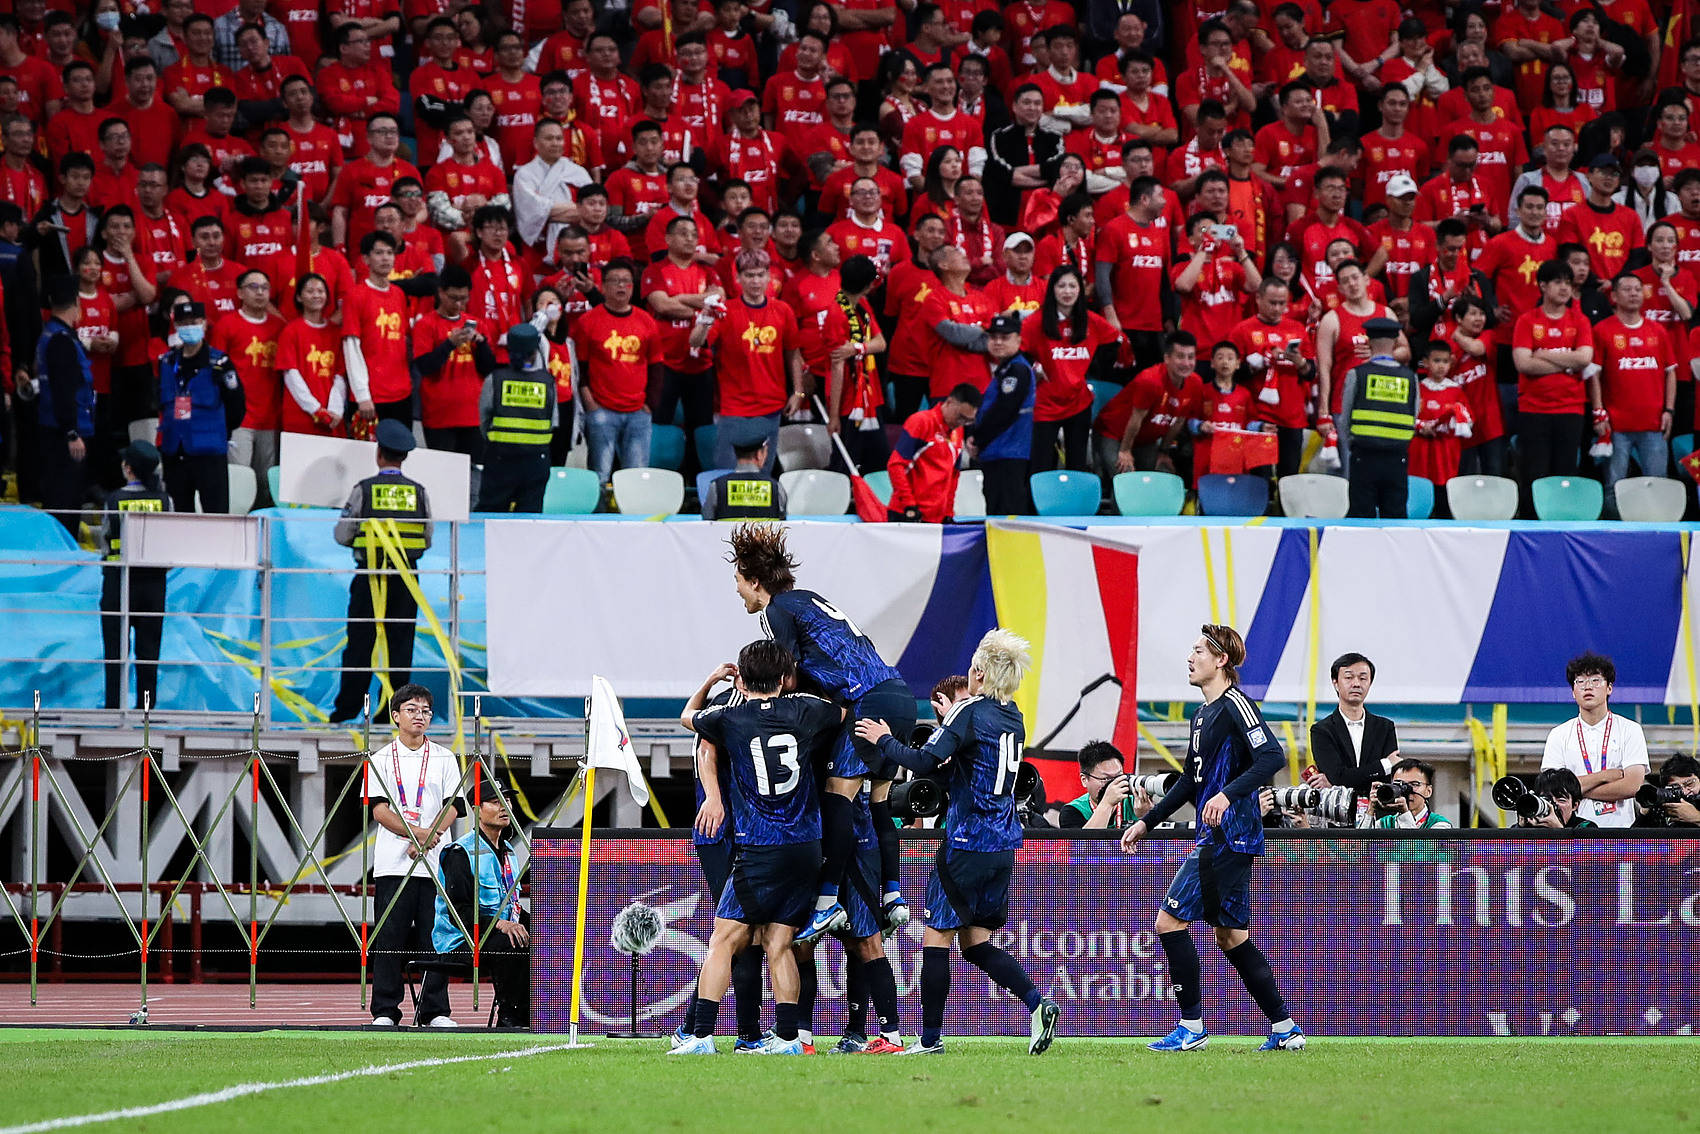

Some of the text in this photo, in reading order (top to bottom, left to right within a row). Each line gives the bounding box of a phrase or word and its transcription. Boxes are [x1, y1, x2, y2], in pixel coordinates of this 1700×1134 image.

[750, 734, 800, 795] 13
[994, 732, 1023, 795] 14
[954, 918, 1157, 958] elcome
